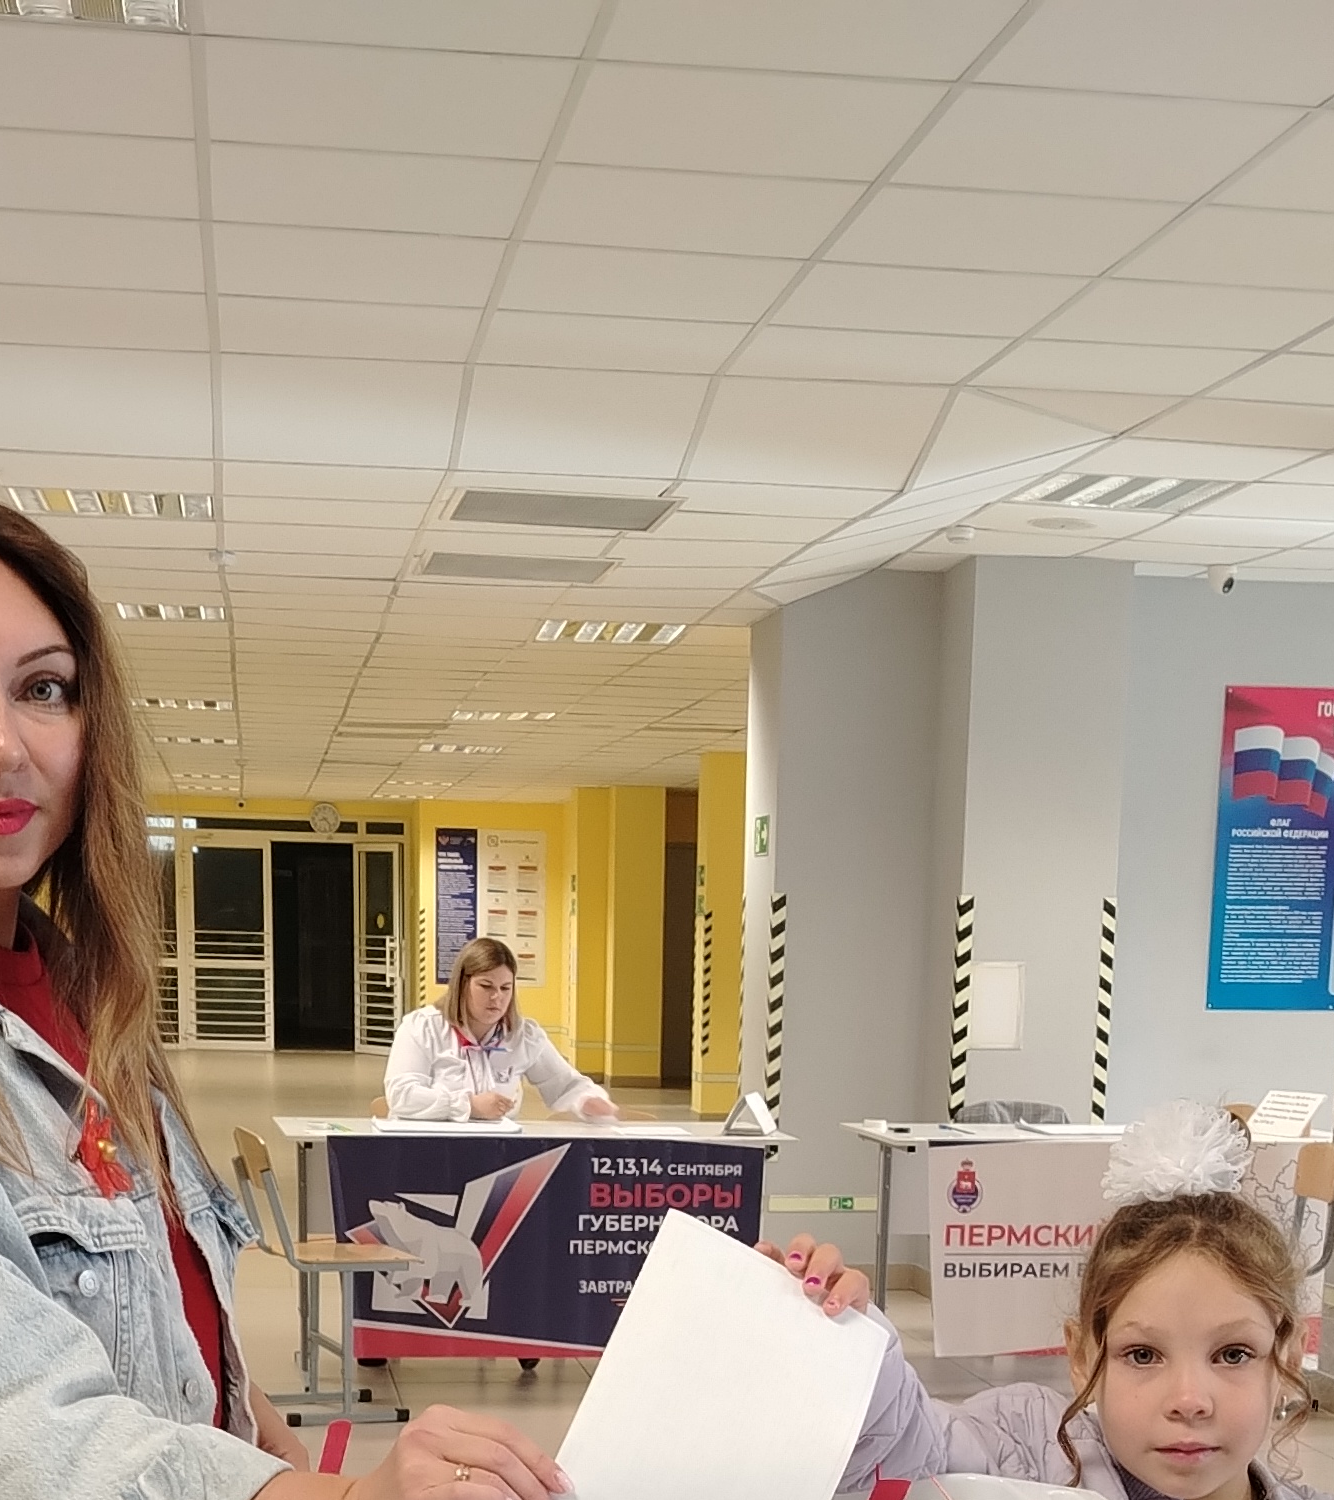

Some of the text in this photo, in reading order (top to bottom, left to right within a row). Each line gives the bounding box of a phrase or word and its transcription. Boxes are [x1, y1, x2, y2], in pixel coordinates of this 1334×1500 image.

[1269, 818, 1292, 828] ФЛАГ
[1231, 827, 1329, 840] РОССИЙСКОЙ ФЕДЕРАЦИИ
[590, 1156, 743, 1178] 12,13,14 СЕНТЯБРЯ
[589, 1182, 743, 1209] ВЫБОРЫ
[578, 1214, 740, 1233] ГУБЕРНРА
[944, 1224, 1097, 1248] ПЕРМСКИ
[569, 1239, 655, 1255] ПЕРМСК
[943, 1262, 1070, 1279] ВЫБИРАЕМ
[578, 1279, 634, 1294] ЗАВТРА
